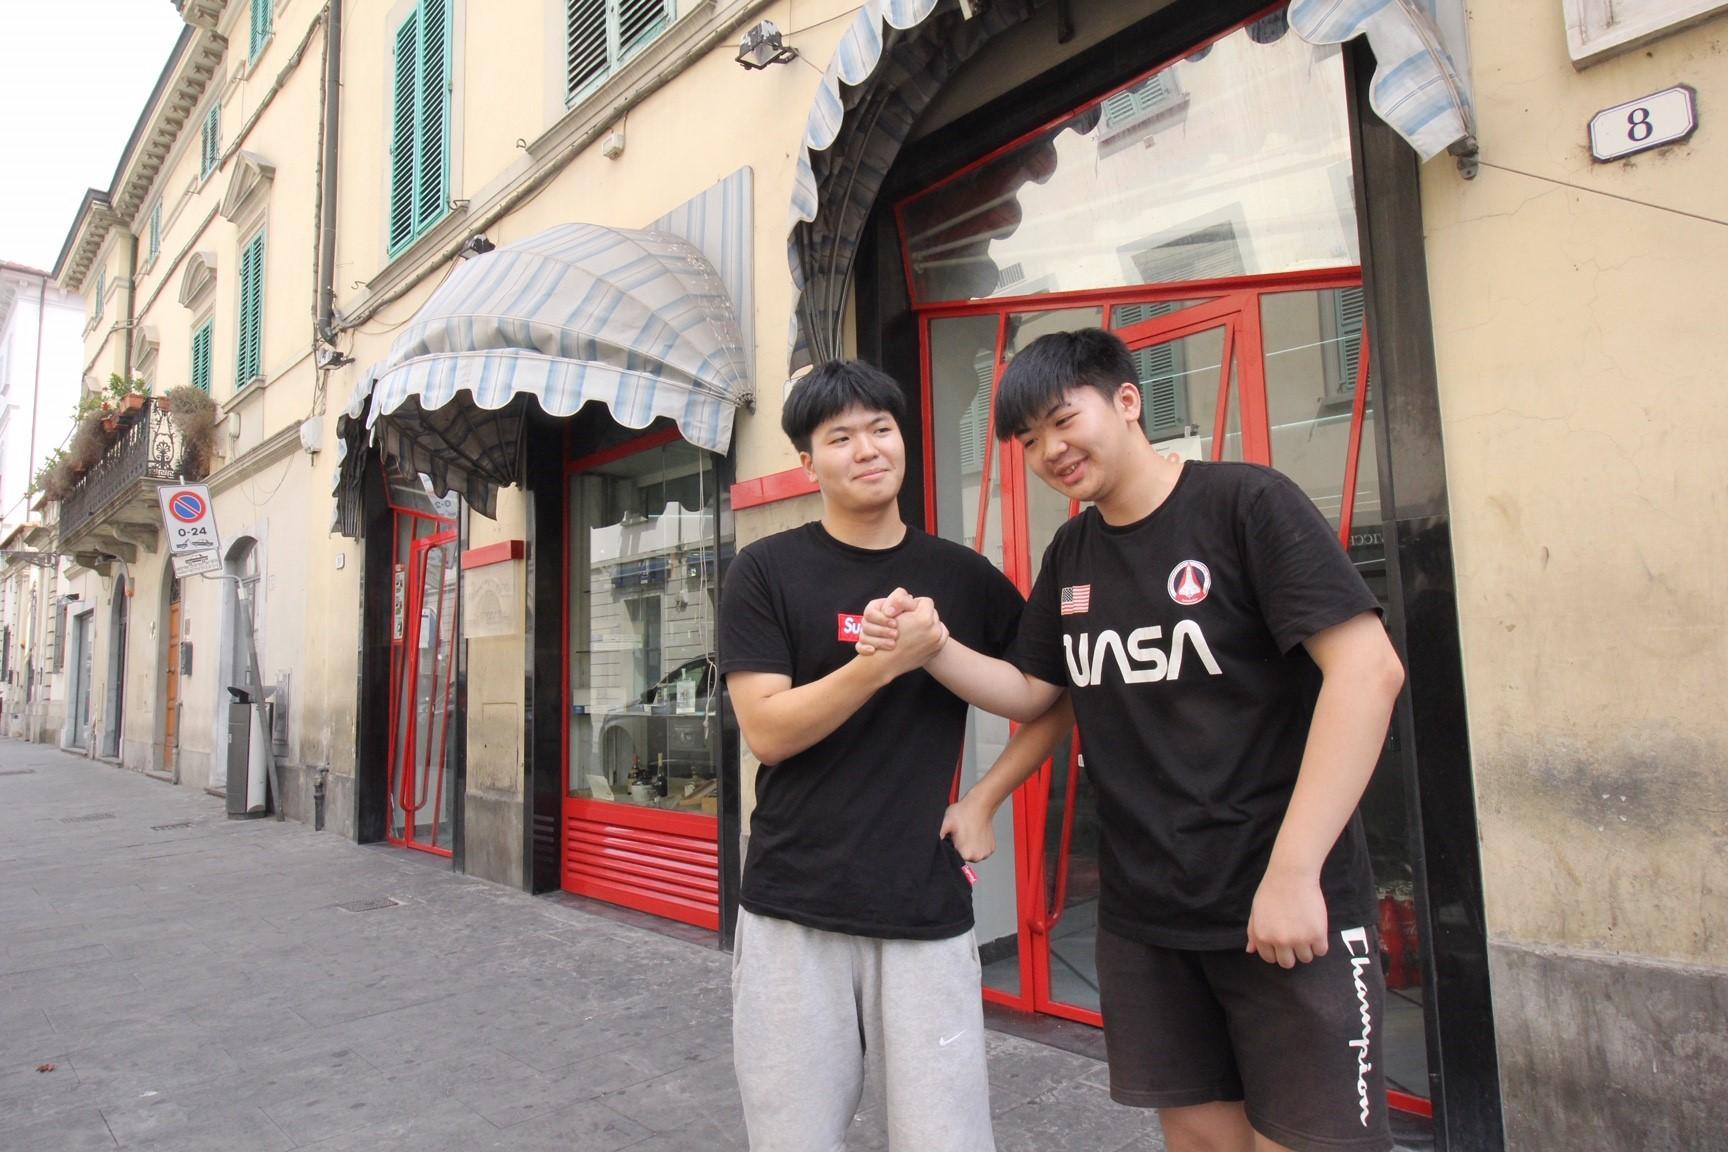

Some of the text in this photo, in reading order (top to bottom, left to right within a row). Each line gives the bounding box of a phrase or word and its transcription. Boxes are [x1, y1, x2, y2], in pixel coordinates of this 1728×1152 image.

[1627, 107, 1653, 142] 8
[178, 527, 207, 537] 0-24
[1063, 619, 1223, 687] NASA
[1341, 926, 1371, 1127] Champion
